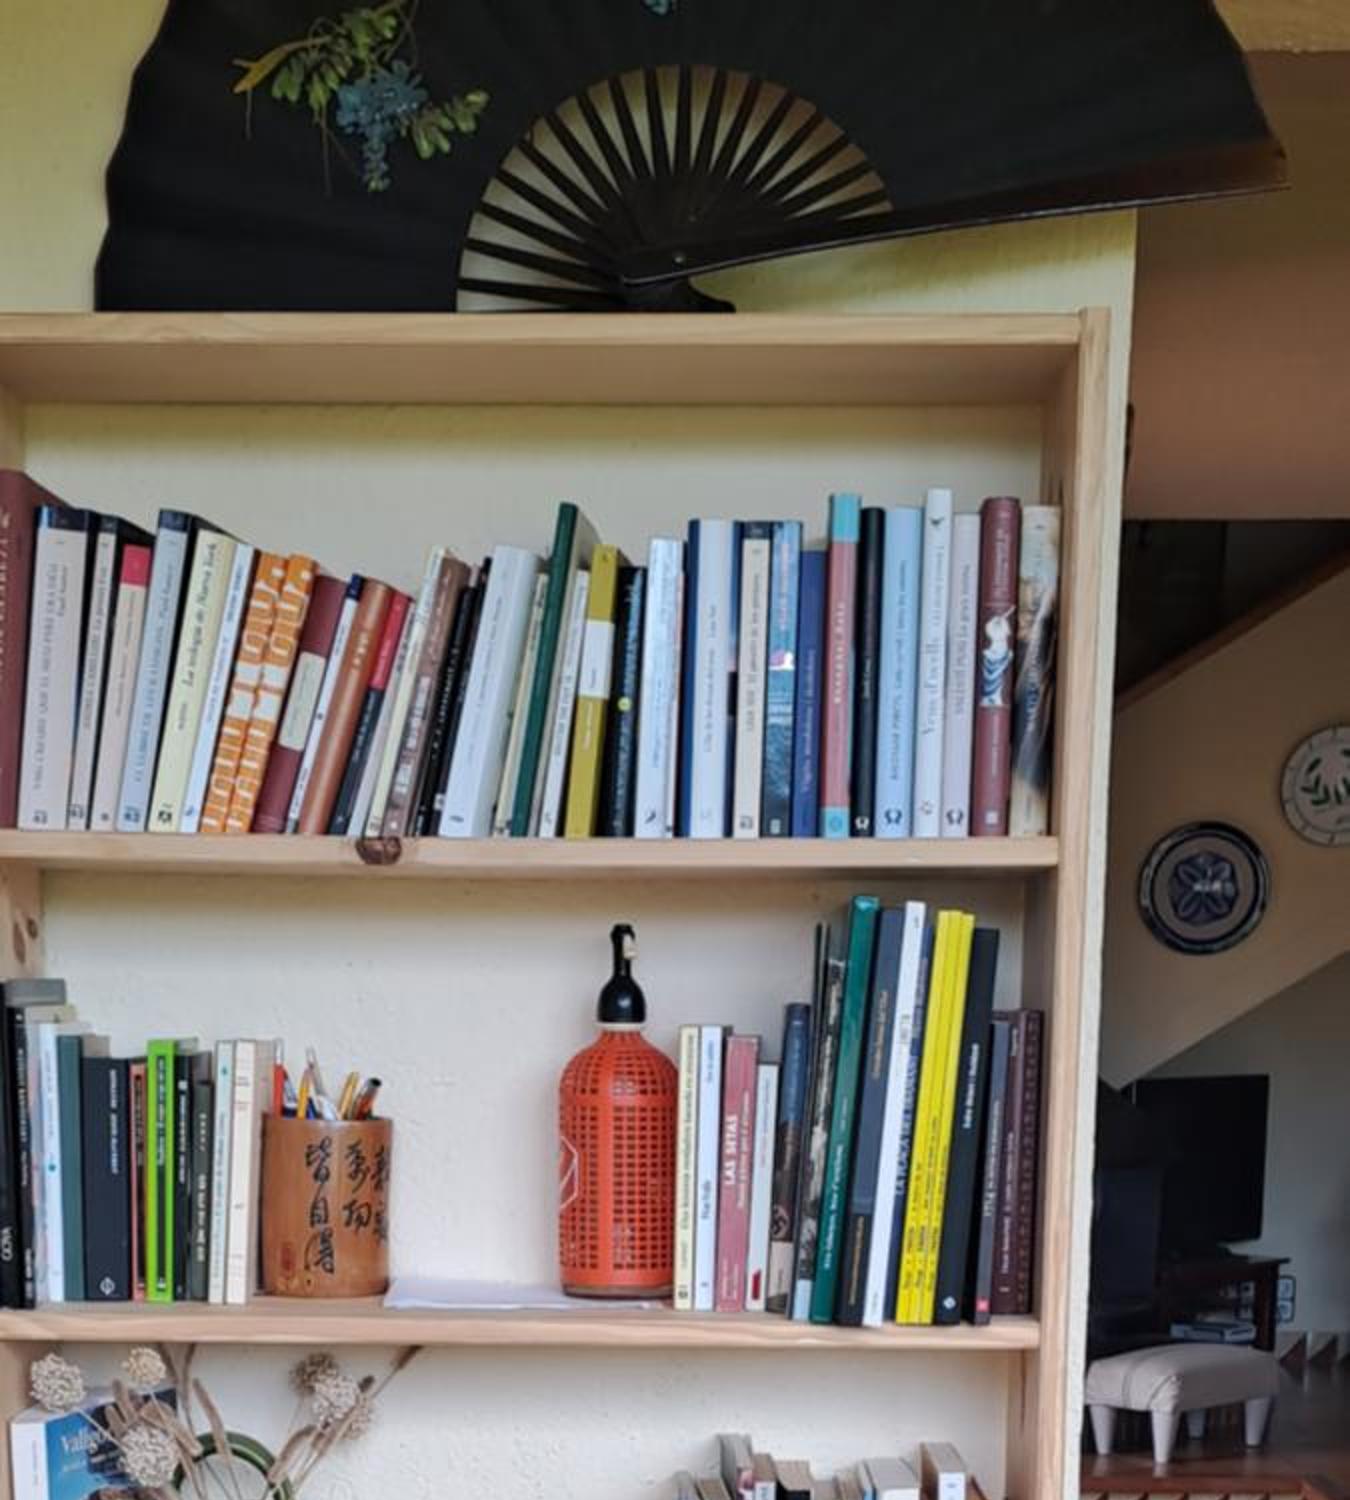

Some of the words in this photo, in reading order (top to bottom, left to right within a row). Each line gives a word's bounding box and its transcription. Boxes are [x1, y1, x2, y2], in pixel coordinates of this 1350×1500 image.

[724, 1113, 739, 1155] SETAS
[723, 1159, 736, 1185] LAS
[2, 1226, 14, 1262] GOYA
